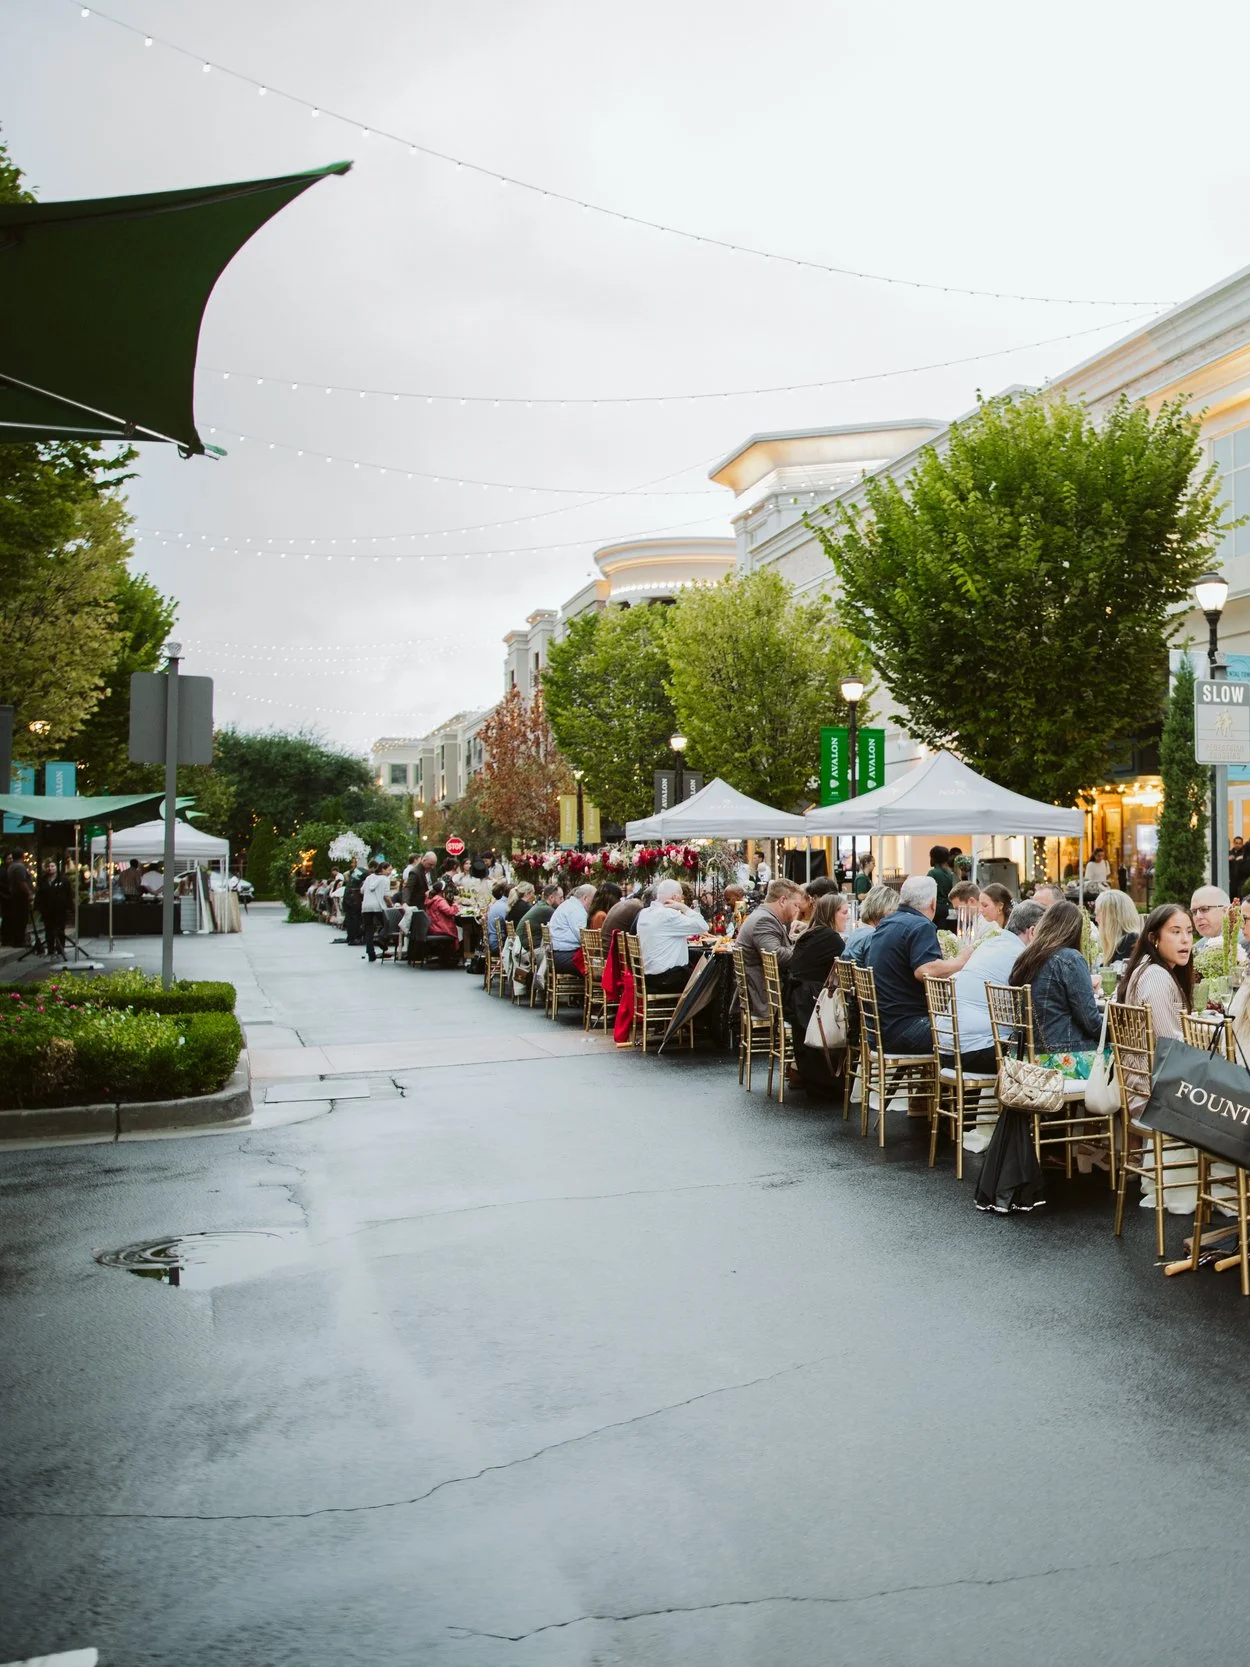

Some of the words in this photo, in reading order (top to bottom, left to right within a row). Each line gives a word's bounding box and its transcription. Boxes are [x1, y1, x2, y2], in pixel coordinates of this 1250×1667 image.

[1203, 684, 1244, 703] SLOW
[831, 736, 839, 778] AVALON
[868, 738, 876, 778] AVALON
[448, 842, 464, 850] STOP
